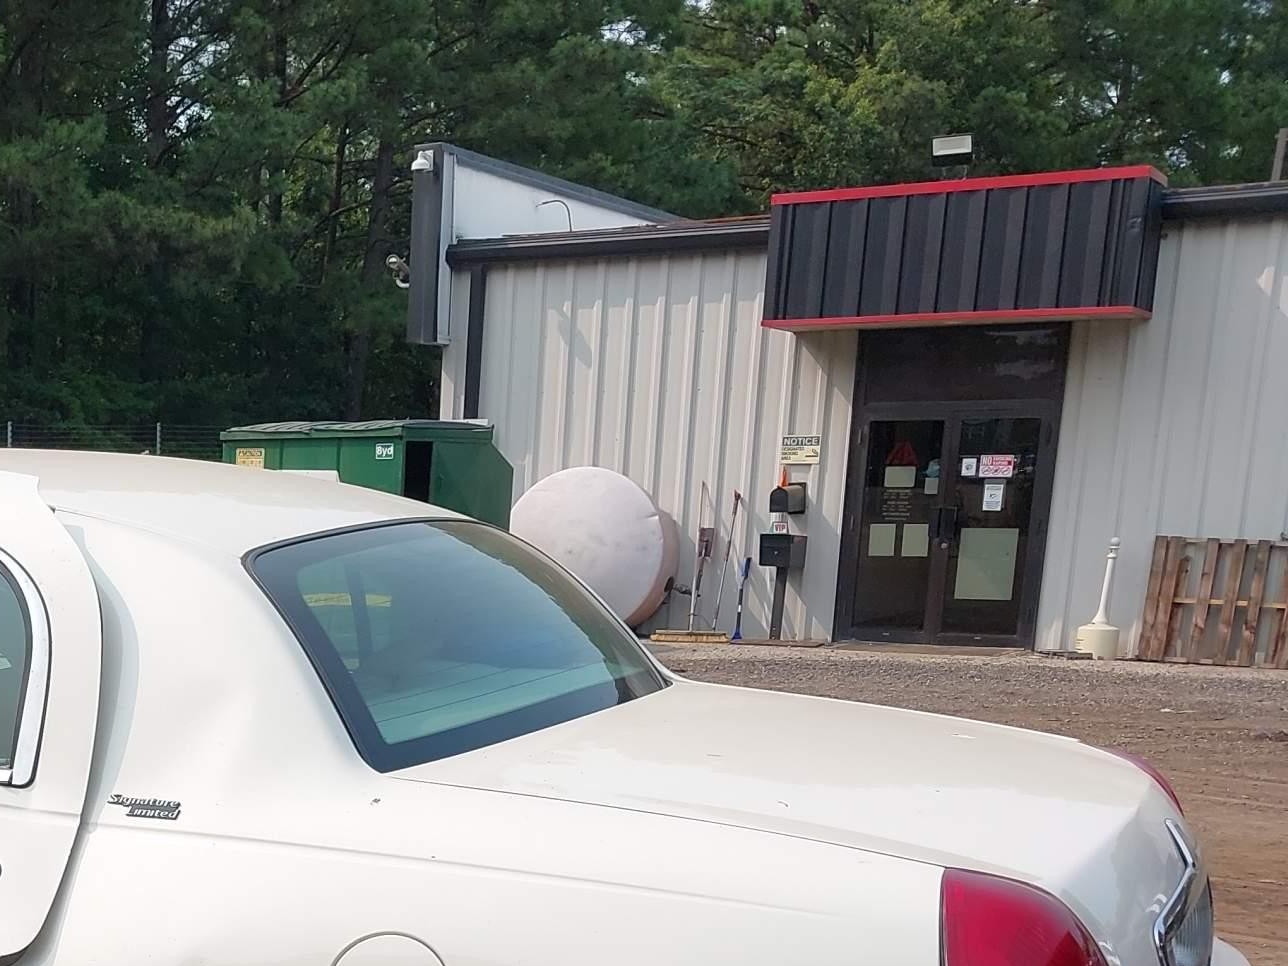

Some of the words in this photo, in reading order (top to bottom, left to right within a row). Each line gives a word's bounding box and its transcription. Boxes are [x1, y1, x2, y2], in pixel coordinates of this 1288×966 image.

[783, 437, 818, 446] NOTICE
[376, 446, 393, 457] 8yd
[107, 794, 181, 808] Signature
[126, 806, 181, 820] Limited
